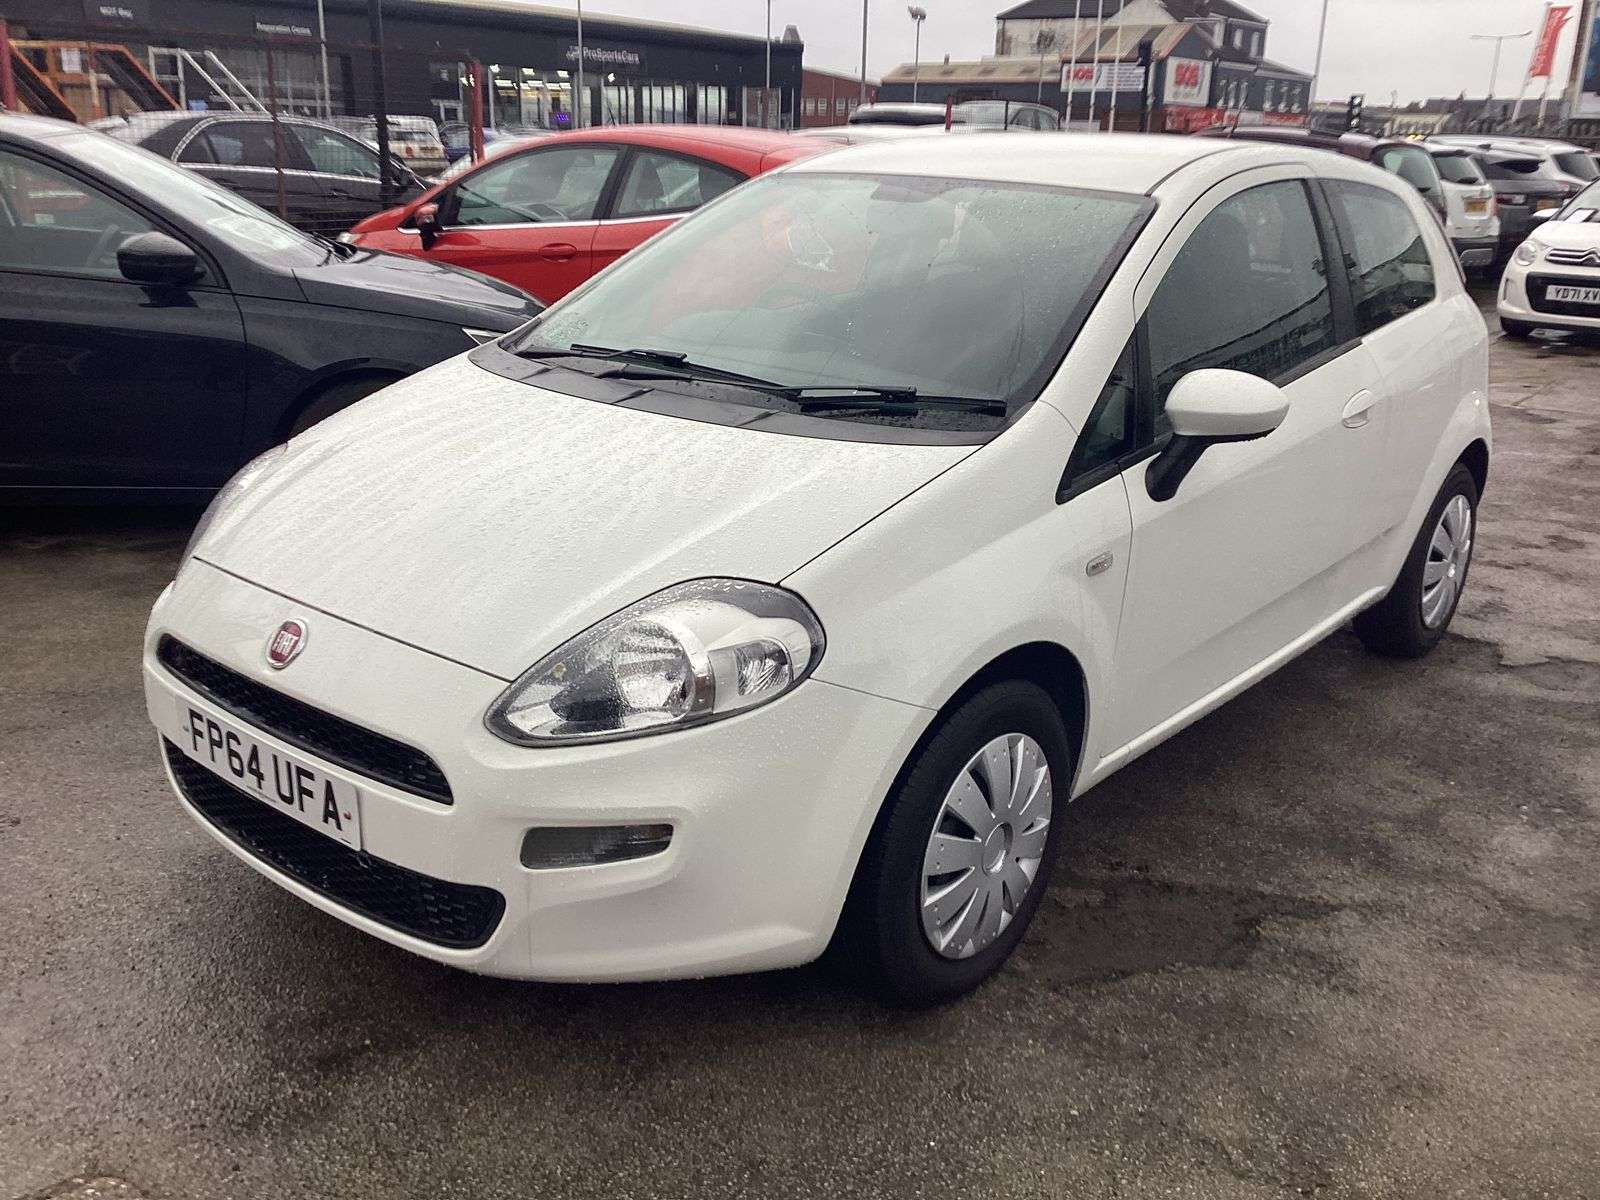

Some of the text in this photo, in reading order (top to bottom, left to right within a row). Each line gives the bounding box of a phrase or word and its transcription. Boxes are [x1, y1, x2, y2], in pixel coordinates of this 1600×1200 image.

[1554, 287, 1600, 301] YD71 XV
[188, 708, 343, 822] FP64 UFA
